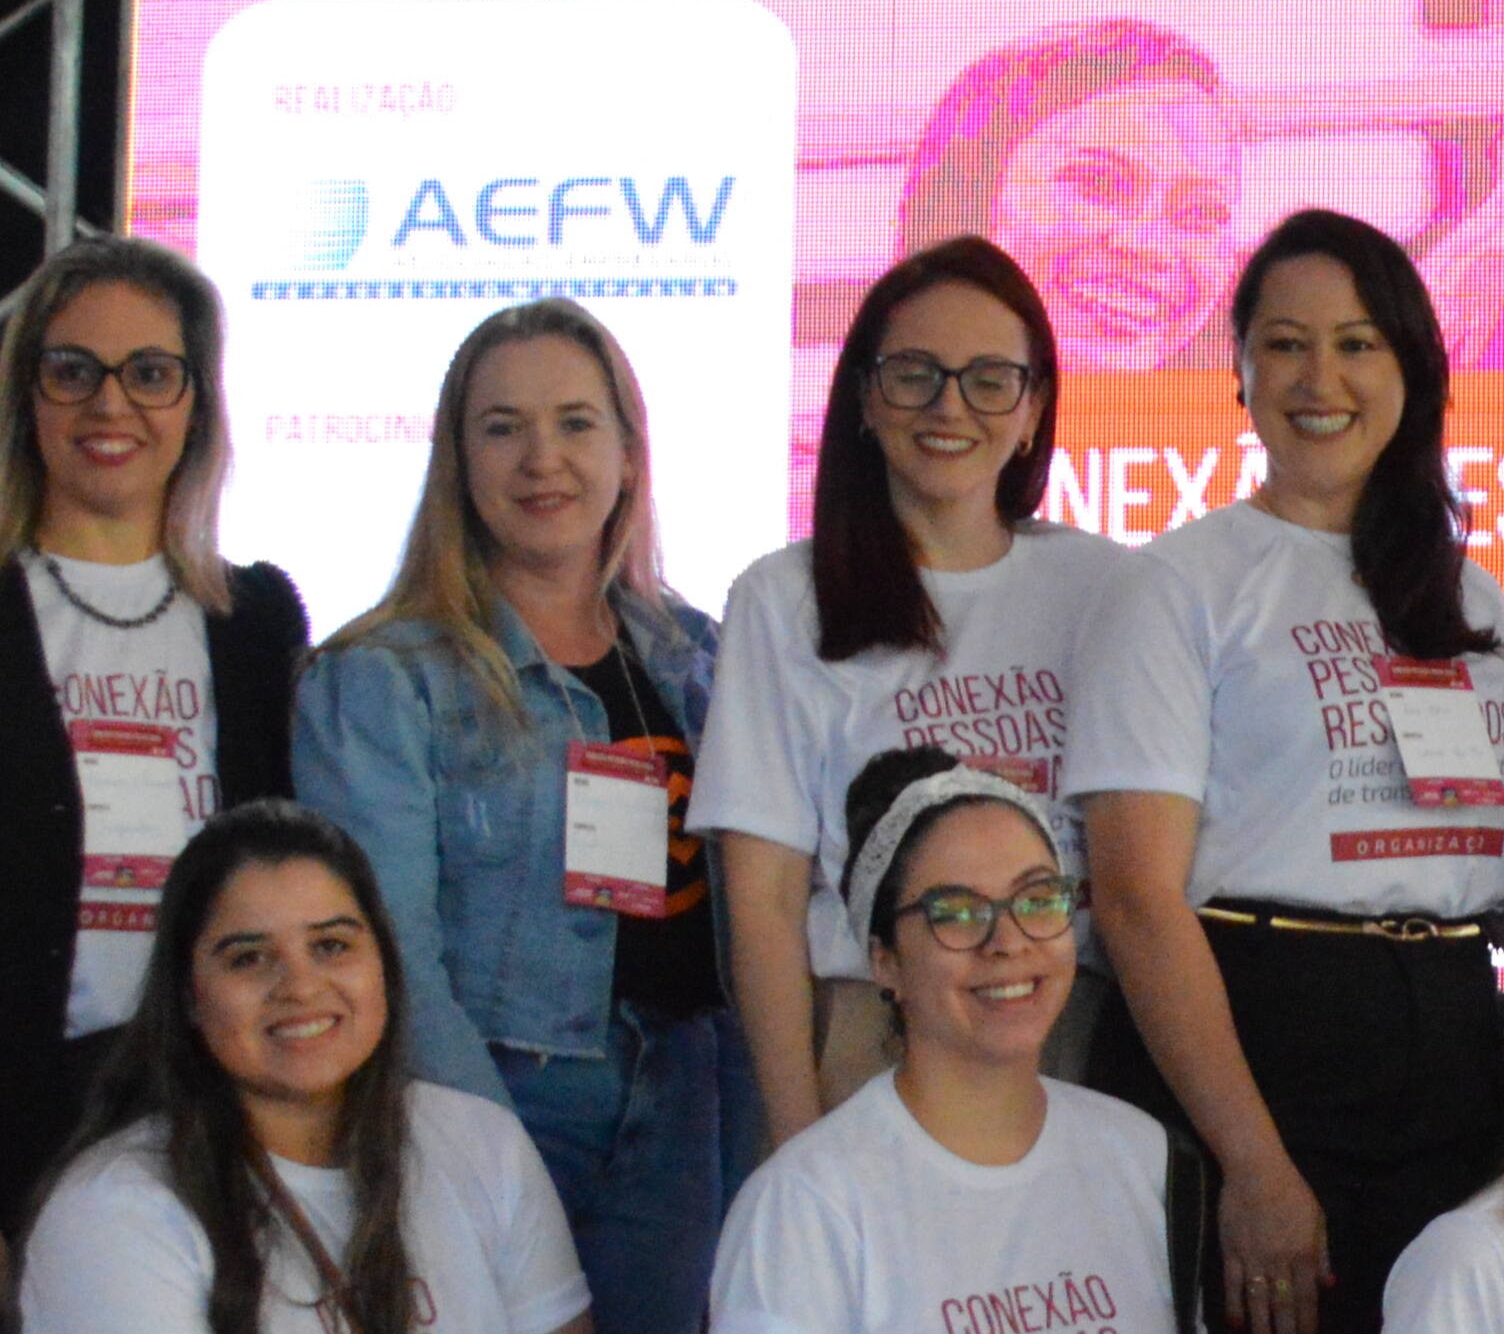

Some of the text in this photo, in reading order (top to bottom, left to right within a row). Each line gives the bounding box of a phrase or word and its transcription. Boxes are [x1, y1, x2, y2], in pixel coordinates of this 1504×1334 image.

[273, 80, 458, 121] REALIZAÇÃO
[391, 175, 736, 247] AEFW
[1291, 619, 1392, 657] CONE
[894, 666, 1065, 723] CONEXÃO
[904, 708, 1068, 757] PESSOAS
[1329, 760, 1343, 780] O
[1357, 835, 1486, 856] ORGANIZAÇ
